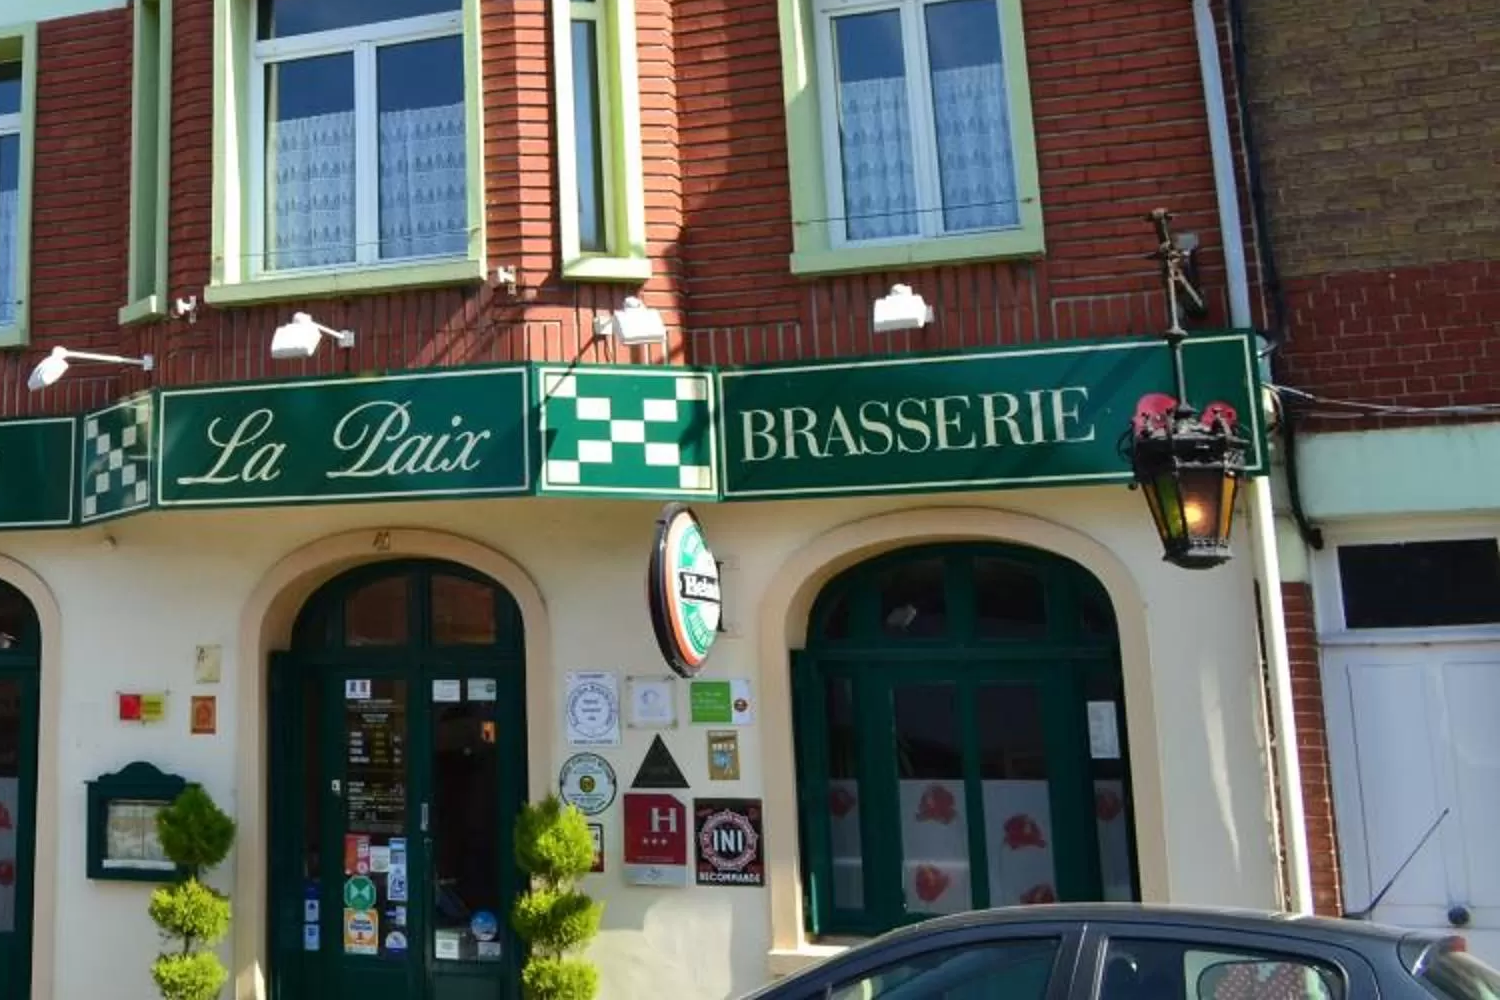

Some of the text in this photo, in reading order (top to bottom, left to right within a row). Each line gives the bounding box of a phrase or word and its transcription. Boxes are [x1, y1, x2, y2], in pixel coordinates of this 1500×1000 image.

[176, 400, 491, 485] La Paix
[739, 386, 1095, 463] BRASSERIE
[651, 807, 677, 833] H
